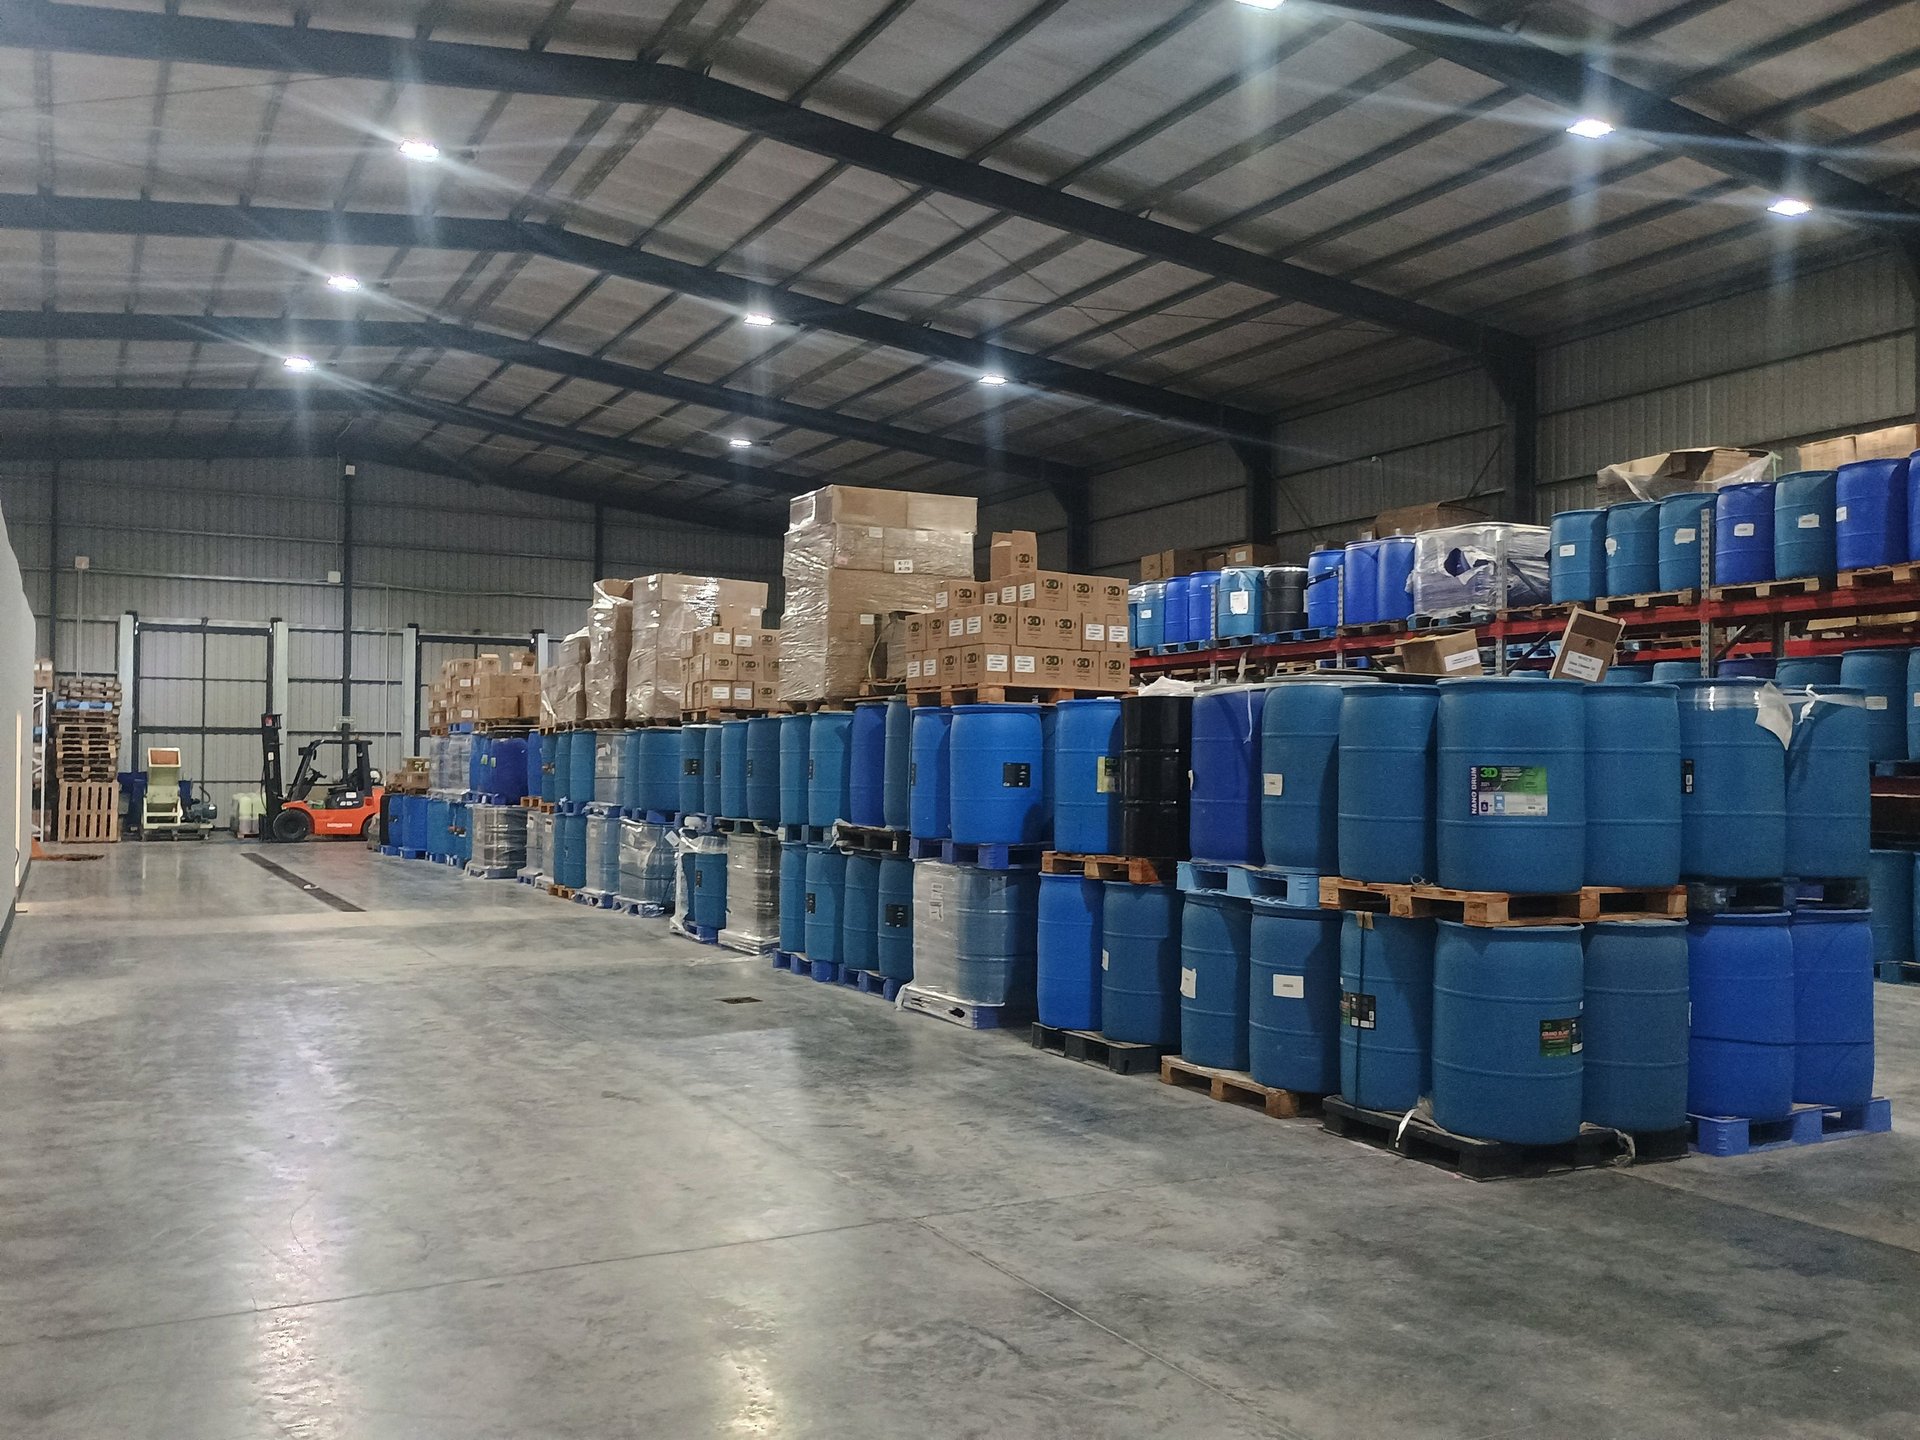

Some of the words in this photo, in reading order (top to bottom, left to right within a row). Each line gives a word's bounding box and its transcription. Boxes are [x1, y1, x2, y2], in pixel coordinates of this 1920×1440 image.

[1019, 553, 1030, 563] 3D
[958, 588, 972, 599] 3D
[1077, 583, 1090, 593] 3D
[1107, 585, 1120, 596] 3D
[993, 613, 1007, 624] 3D
[1027, 615, 1041, 626] 3D
[1059, 618, 1073, 629] 3D
[1046, 655, 1059, 665] 3D
[1077, 658, 1090, 668] 3D
[1108, 660, 1121, 670] 3D
[1480, 767, 1498, 778] 3D
